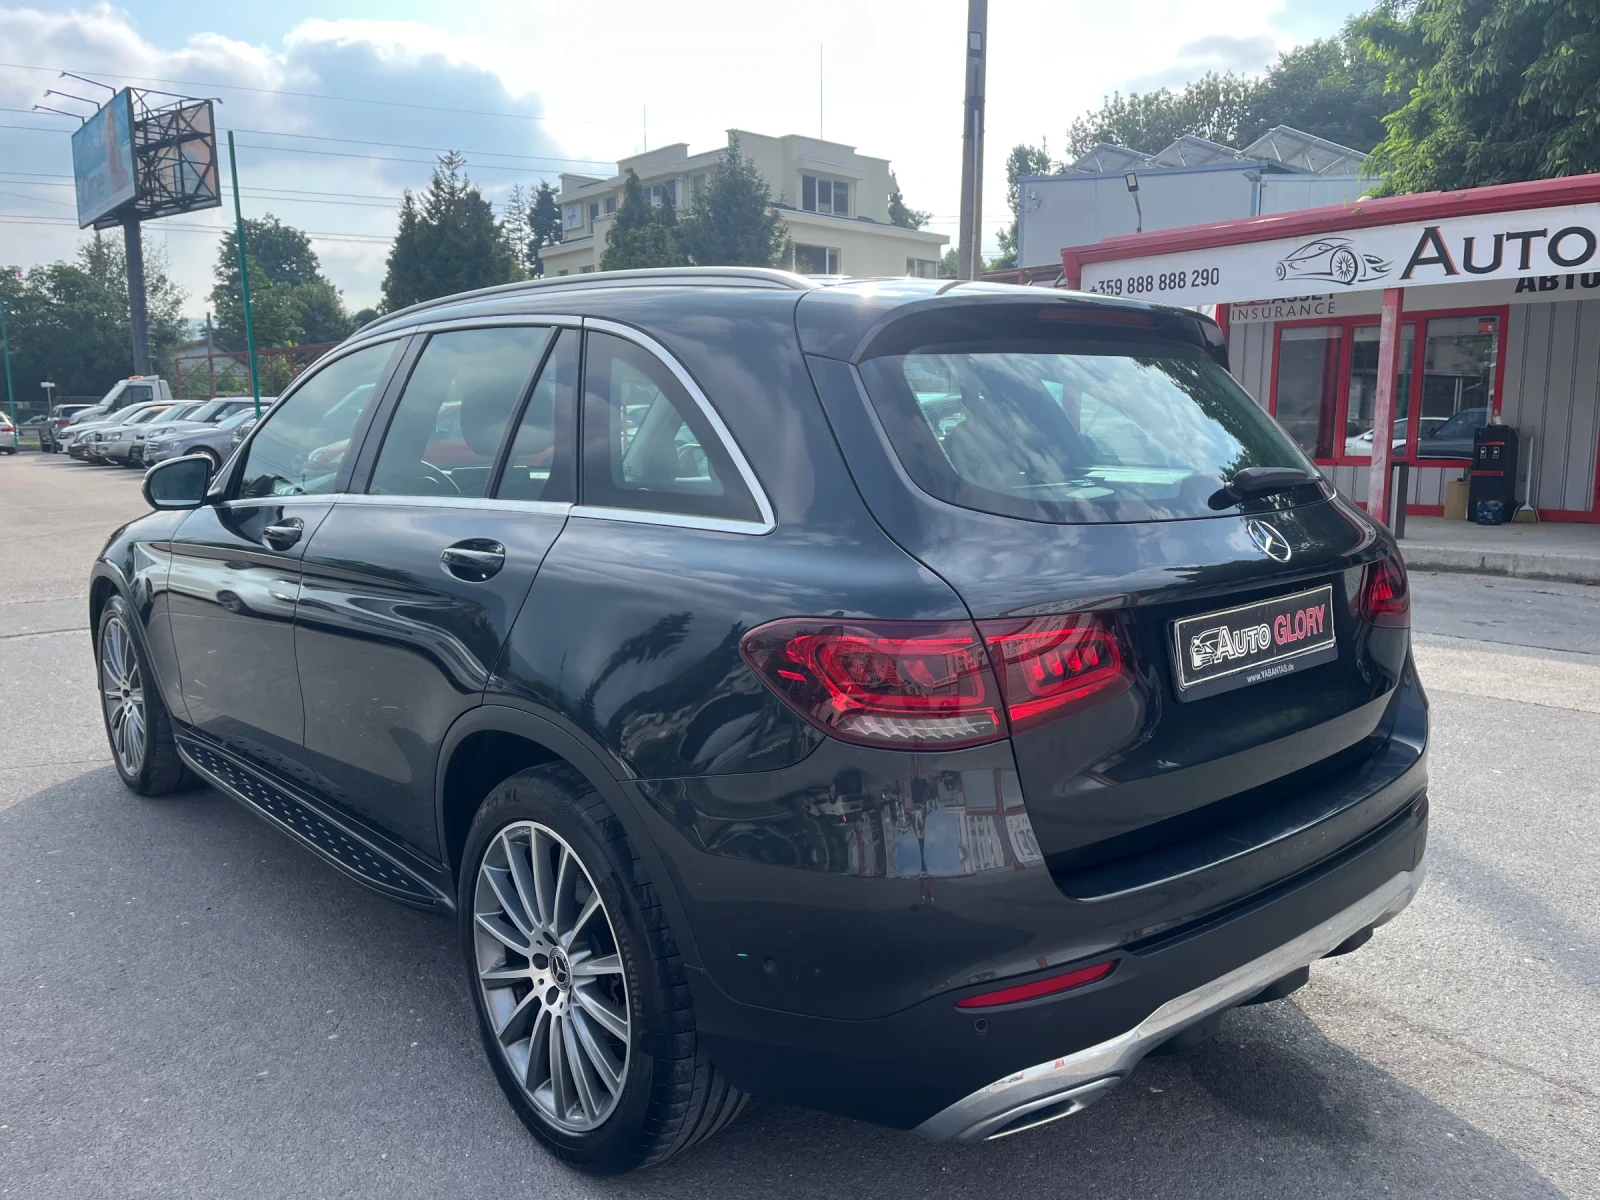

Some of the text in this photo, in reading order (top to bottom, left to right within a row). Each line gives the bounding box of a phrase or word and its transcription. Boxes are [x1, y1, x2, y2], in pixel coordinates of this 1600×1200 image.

[1399, 225, 1598, 281] AUTO
[1090, 267, 1220, 296] +359 888 888 290
[1231, 301, 1337, 321] INSURANCE
[1213, 604, 1327, 664] AUTO GLORY
